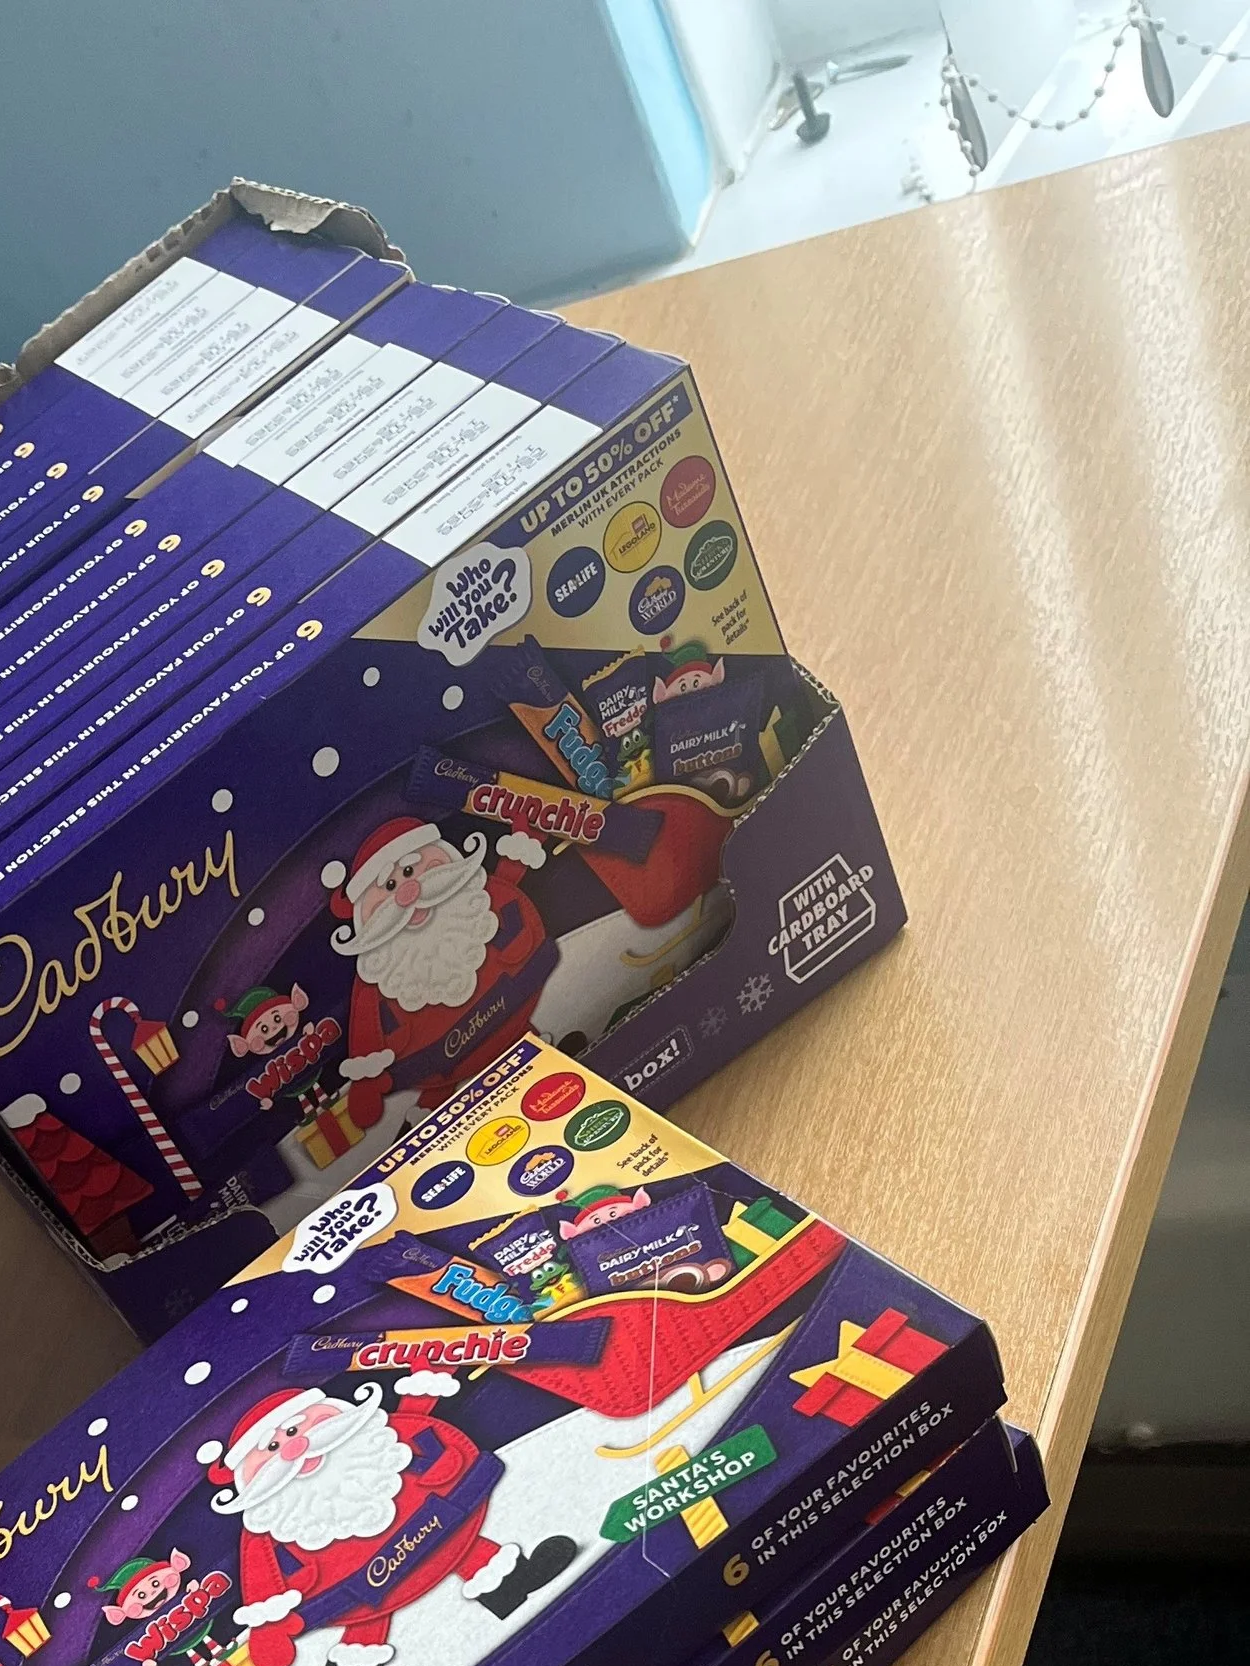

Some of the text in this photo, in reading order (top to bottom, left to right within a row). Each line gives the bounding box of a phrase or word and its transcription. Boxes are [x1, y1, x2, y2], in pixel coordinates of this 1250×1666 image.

[521, 501, 550, 532] UP
[551, 477, 582, 507] TO
[585, 439, 632, 483] 50%
[275, 643, 294, 660] OF
[297, 620, 322, 638] 6
[230, 661, 273, 691] YOUR
[141, 692, 230, 764] FAVOURITES
[87, 781, 123, 807] THIS
[122, 765, 140, 779] IN
[6, 807, 86, 872] SELECTION
[471, 784, 608, 840] crunchie
[769, 866, 873, 955] CARDBOARD
[793, 870, 836, 911] WITH
[802, 904, 854, 950] TRAY
[624, 1039, 679, 1090] box!
[377, 1148, 406, 1172] UP
[406, 1125, 437, 1147] TO
[437, 1089, 483, 1125] 50%
[525, 1158, 565, 1189] WORLD
[294, 1212, 355, 1261] will you
[309, 1201, 352, 1232] Who
[310, 1193, 381, 1261] Take?
[357, 1329, 530, 1368] crunchie
[624, 1452, 754, 1531] WORKSHOP
[633, 1451, 726, 1510] SANTA'S
[724, 1402, 930, 1585] 6 OF YOUR FAVOURITES
[758, 1403, 953, 1564] IN THIS SELECTION BOX
[369, 1516, 442, 1587] Cadbury
[124, 1571, 232, 1663] Wispa
